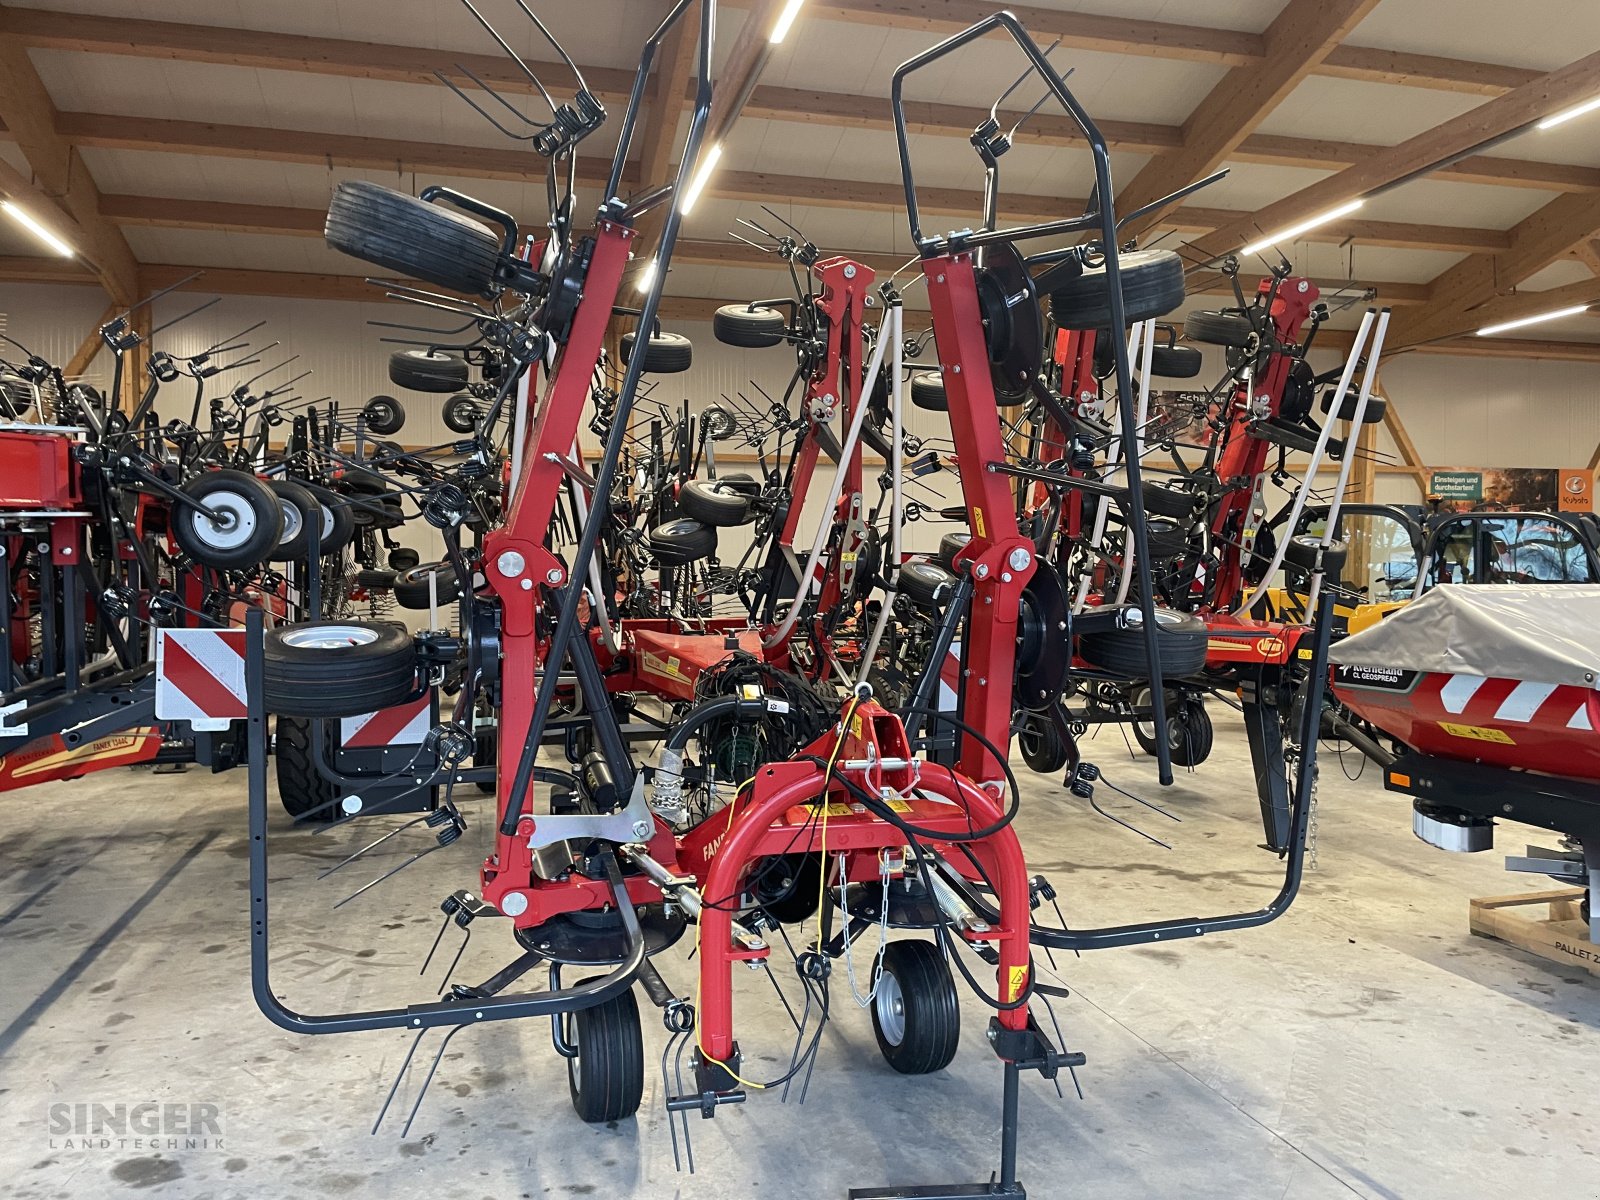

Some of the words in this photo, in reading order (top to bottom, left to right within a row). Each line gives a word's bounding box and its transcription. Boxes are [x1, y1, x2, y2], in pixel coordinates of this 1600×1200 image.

[1178, 393, 1226, 403] Schäer
[1434, 476, 1465, 484] Einsteigen
[1362, 673, 1398, 683] GEOSPREAD
[1555, 941, 1592, 961] PALLET
